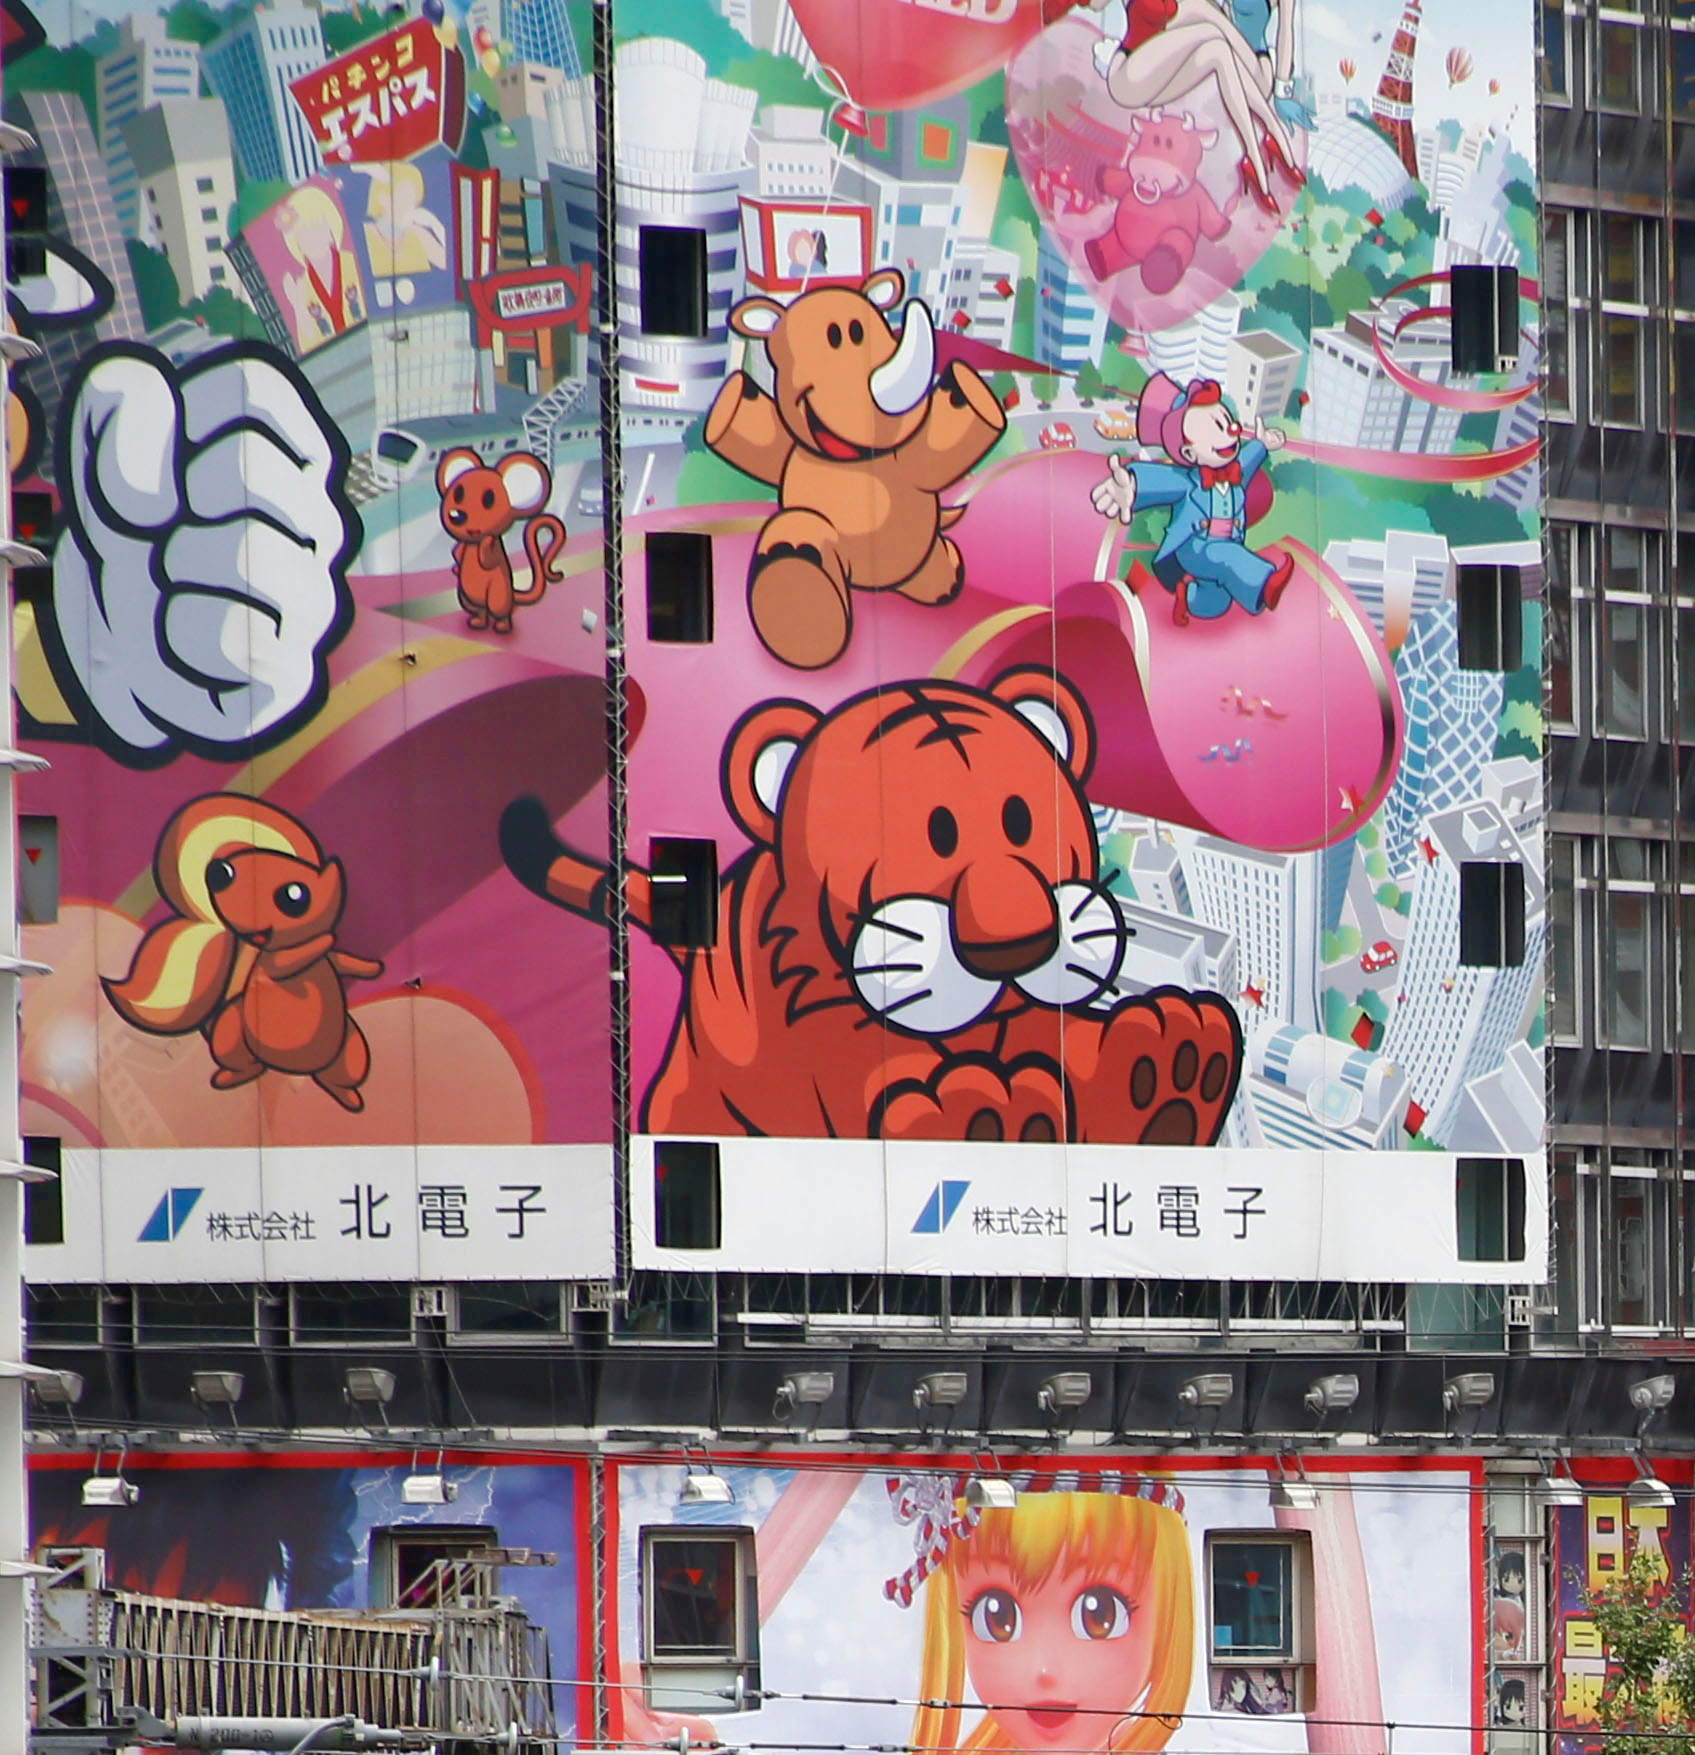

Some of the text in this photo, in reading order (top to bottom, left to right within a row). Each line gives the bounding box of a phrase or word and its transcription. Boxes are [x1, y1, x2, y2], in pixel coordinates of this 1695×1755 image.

[322, 33, 415, 104] パチンコ
[321, 67, 436, 145] エスパス
[206, 1183, 547, 1241] 株式会社 北電子
[972, 1182, 1267, 1240] 株式会社 北電子
